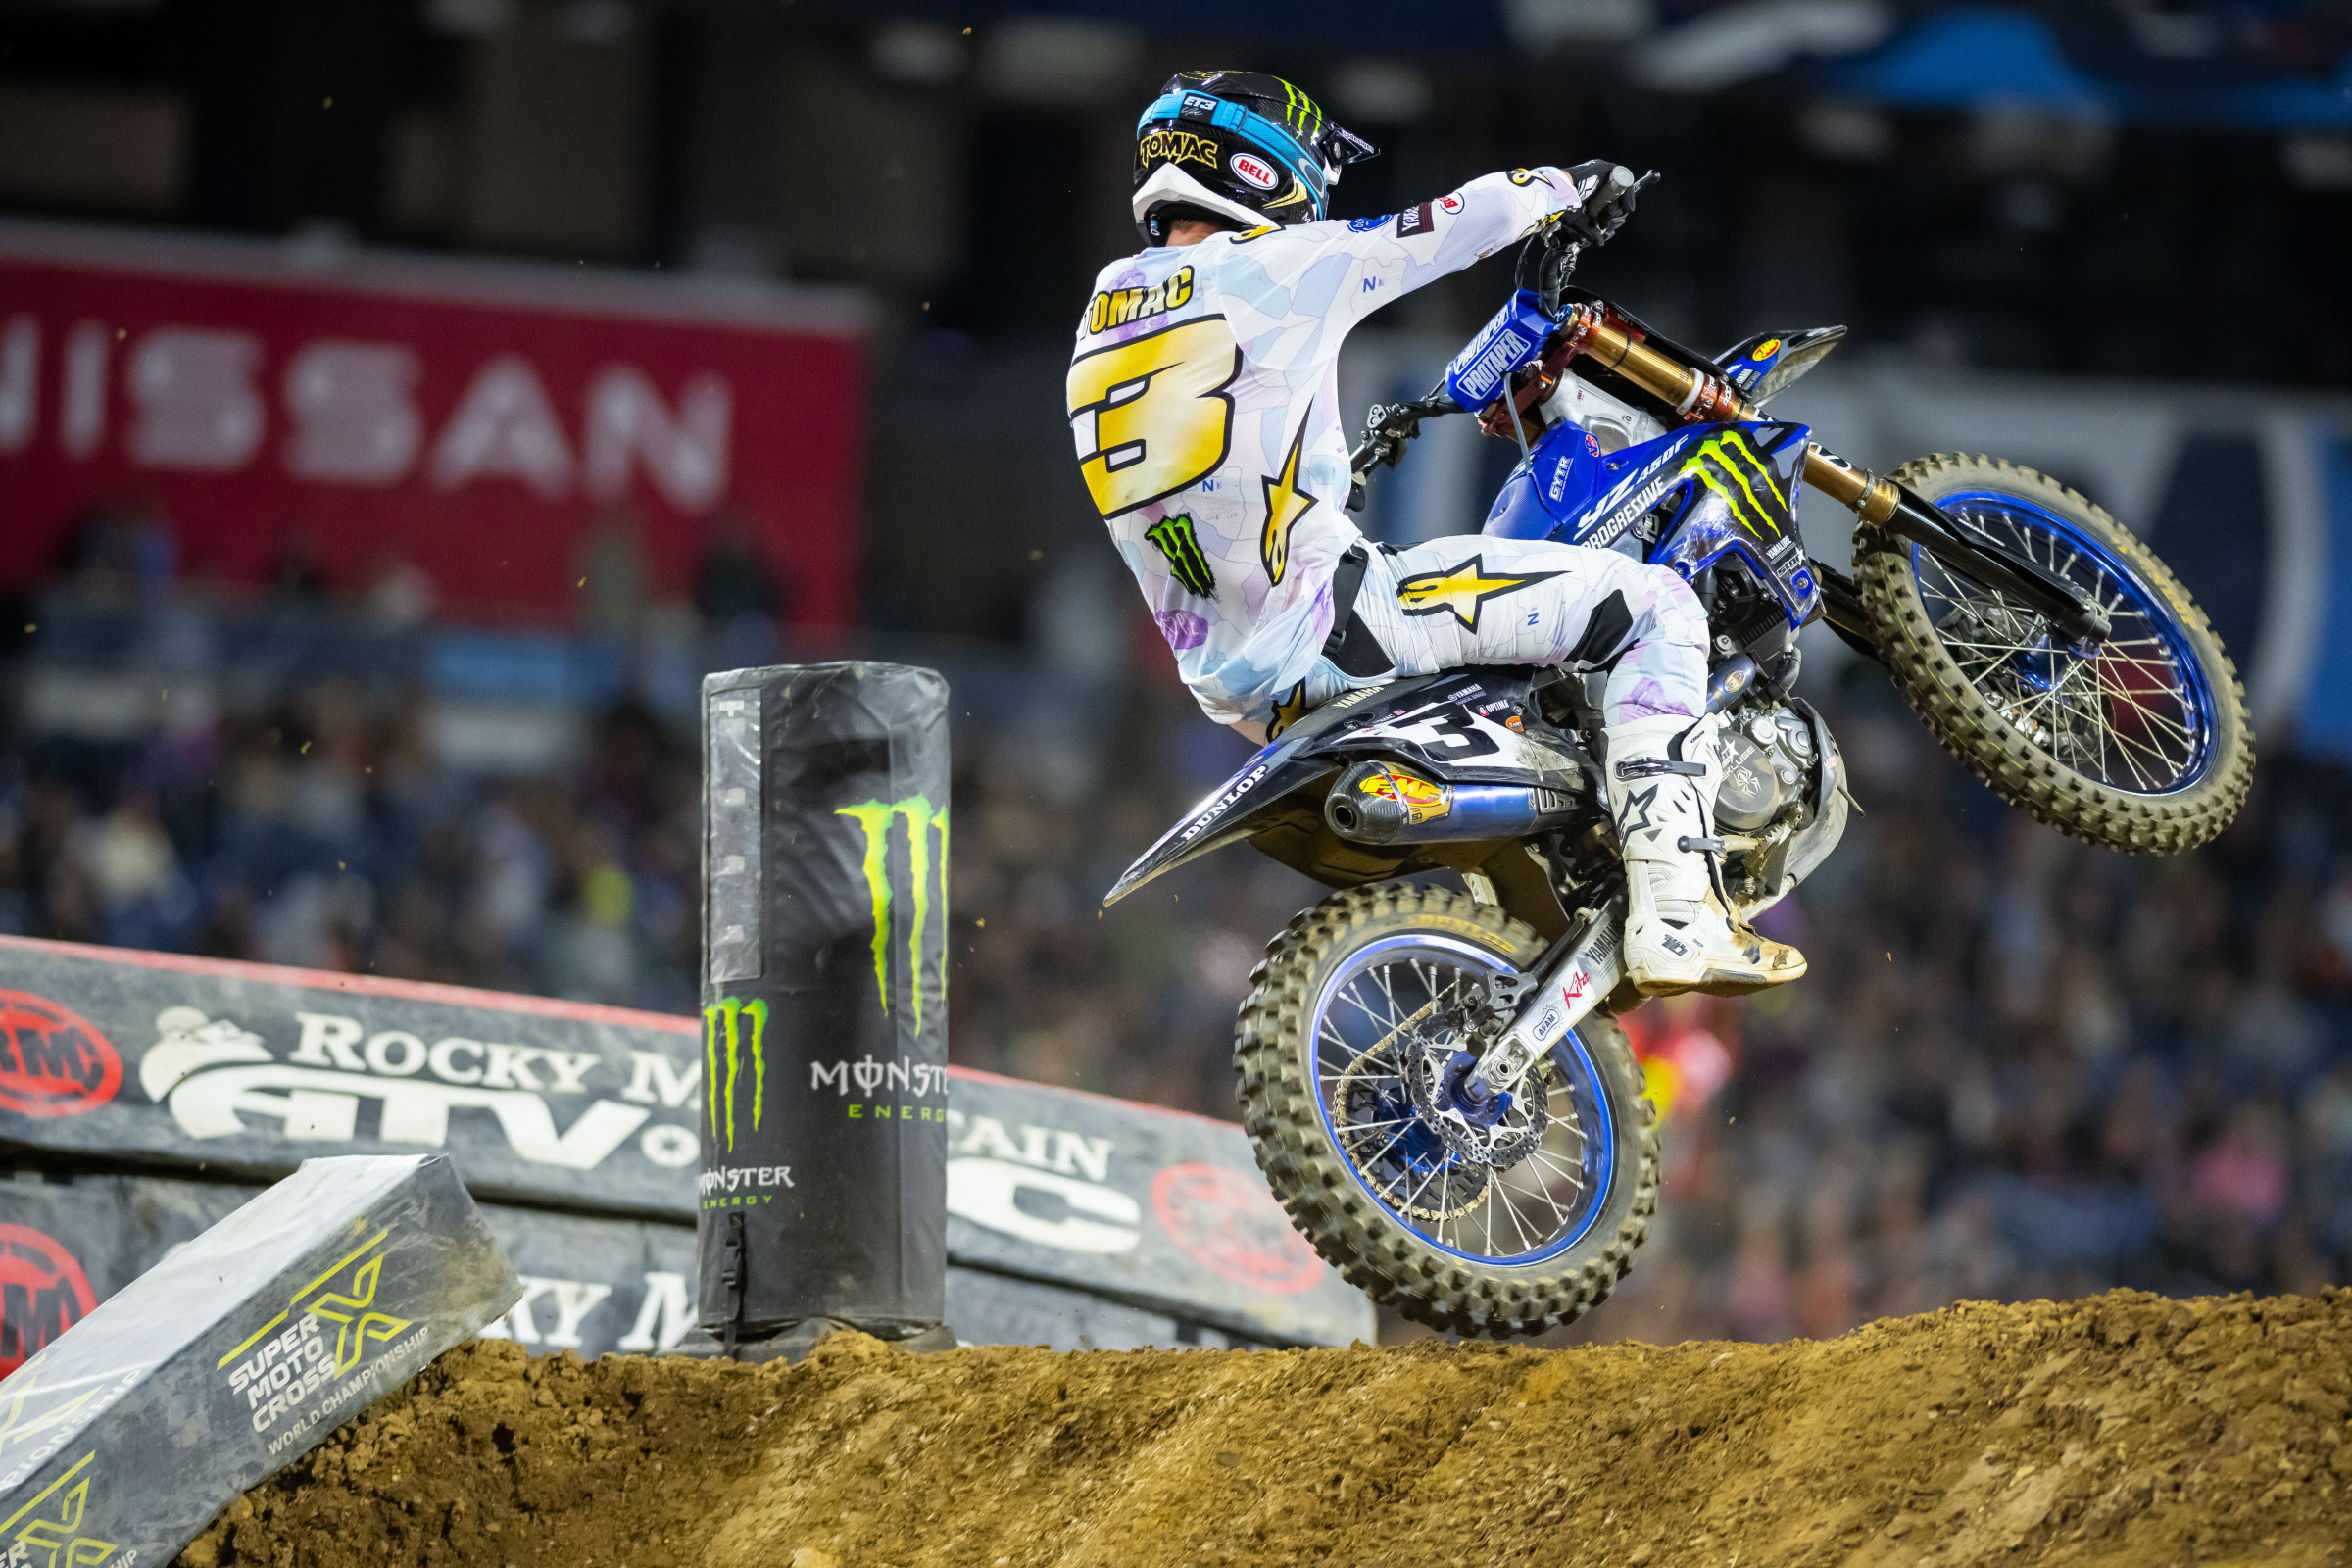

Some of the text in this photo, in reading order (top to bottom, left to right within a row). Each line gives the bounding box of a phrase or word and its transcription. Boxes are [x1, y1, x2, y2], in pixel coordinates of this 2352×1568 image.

[1184, 96, 1217, 111] ET3
[1140, 131, 1218, 169] TOMAC
[1237, 158, 1271, 185] BELL
[1078, 265, 1195, 342] TOMAC
[1456, 306, 1510, 371] PROTAPER
[1463, 333, 1523, 395] PROTAPER
[1067, 314, 1244, 520] 3
[1548, 455, 1571, 502] GYTR
[1573, 433, 1690, 542] YZ 450F
[1765, 534, 1792, 560] YAMALUBE
[1333, 686, 1384, 709] YAMAHA
[1454, 683, 1483, 699] YAMAHA
[1485, 699, 1510, 713] OPTIMA
[1722, 745, 1756, 781] EKLUSE
[1180, 764, 1267, 841] DUNLOP
[1562, 971, 1591, 1010] Kite
[1538, 1013, 1556, 1037] AFAM
[288, 1011, 602, 1093] ROCKY
[811, 1054, 948, 1098] MONST
[848, 1104, 945, 1123] ENERG
[704, 1195, 772, 1210] ENERGY
[228, 1313, 321, 1396] SUPER
[247, 1335, 324, 1410] MOTO
[252, 1352, 336, 1433] CROSS
[268, 1326, 430, 1456] WORLD CHAMPIONSHIP
